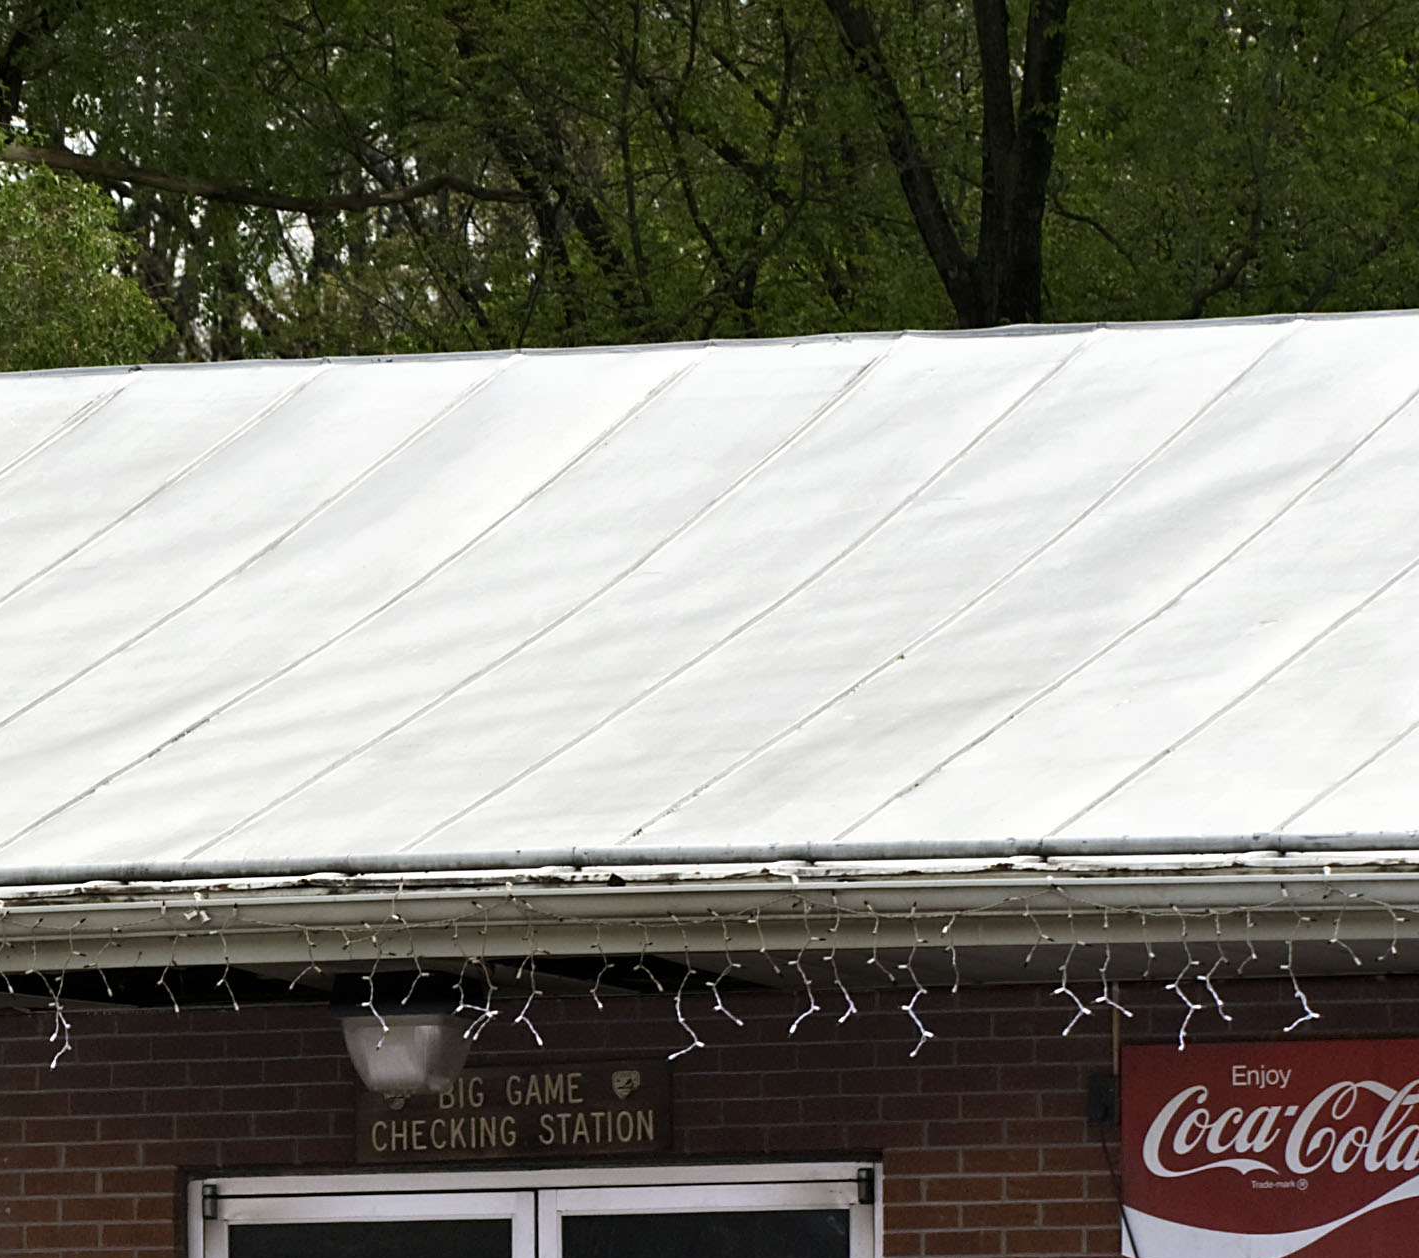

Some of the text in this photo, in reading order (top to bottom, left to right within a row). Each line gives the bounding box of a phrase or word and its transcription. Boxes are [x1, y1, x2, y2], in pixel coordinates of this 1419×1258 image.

[439, 1073, 584, 1109] BIG GAME
[1232, 1065, 1291, 1089] Enjoy
[371, 1110, 656, 1151] CHECKING STATION
[1143, 1079, 1419, 1178] Coca-Cola
[1251, 1180, 1296, 1190] Trade-mark
